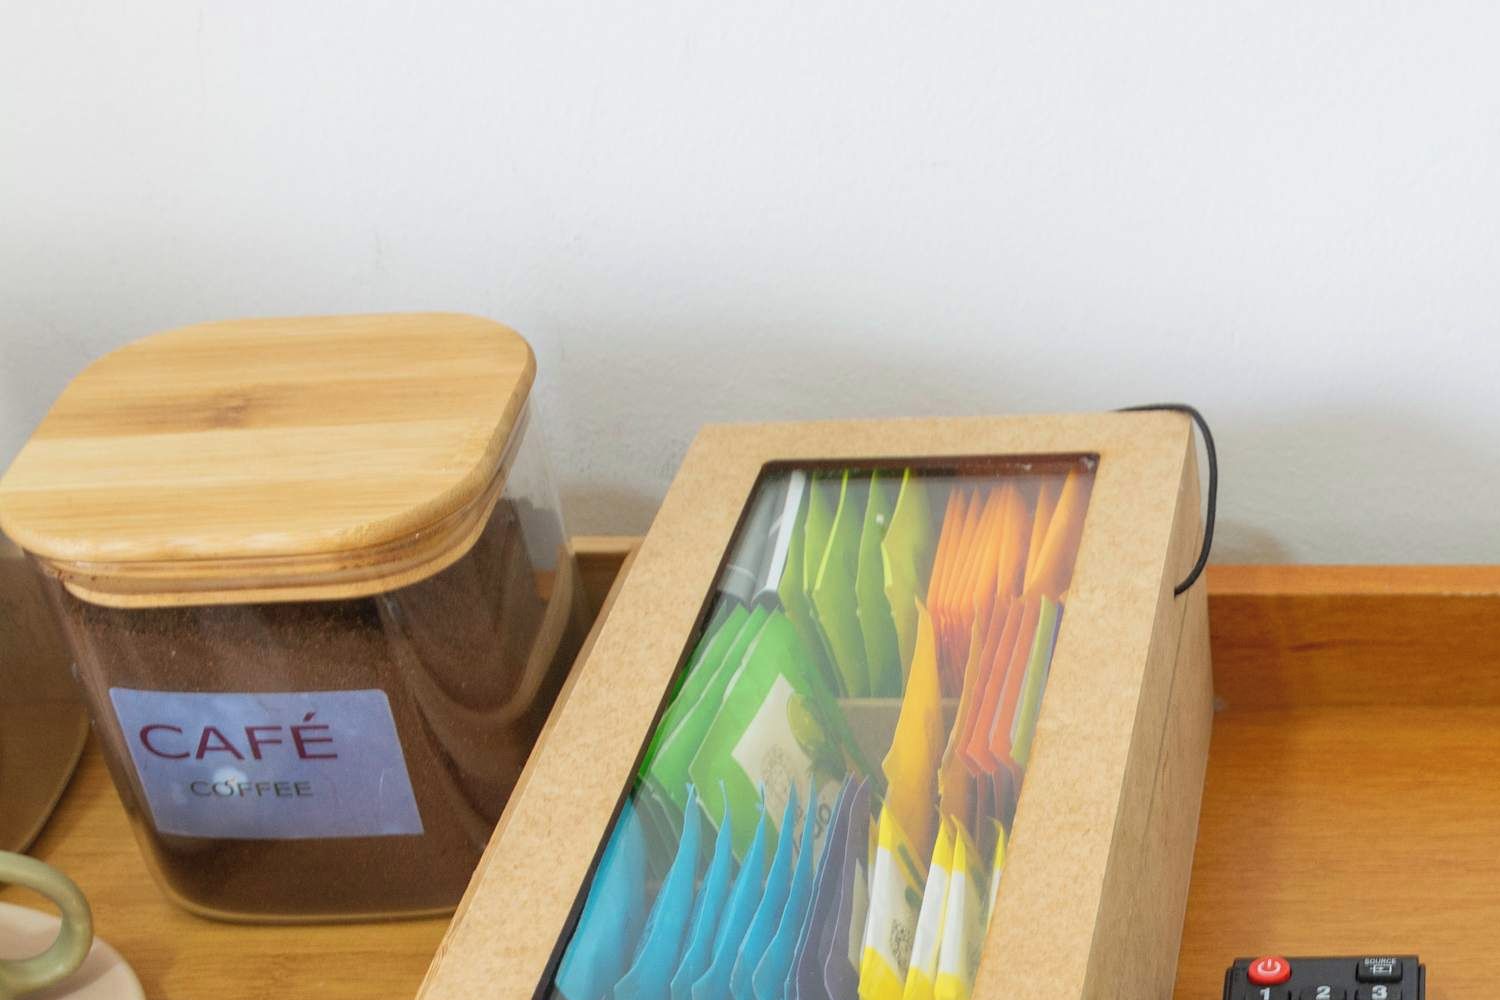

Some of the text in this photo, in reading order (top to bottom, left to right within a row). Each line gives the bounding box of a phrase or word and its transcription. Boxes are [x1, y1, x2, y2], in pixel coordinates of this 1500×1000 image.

[139, 712, 338, 761] CAFÉ
[190, 780, 314, 799] COFFEE
[1364, 957, 1396, 966] SOURCE
[1316, 986, 1331, 1000] 2
[1372, 985, 1388, 1000] 3
